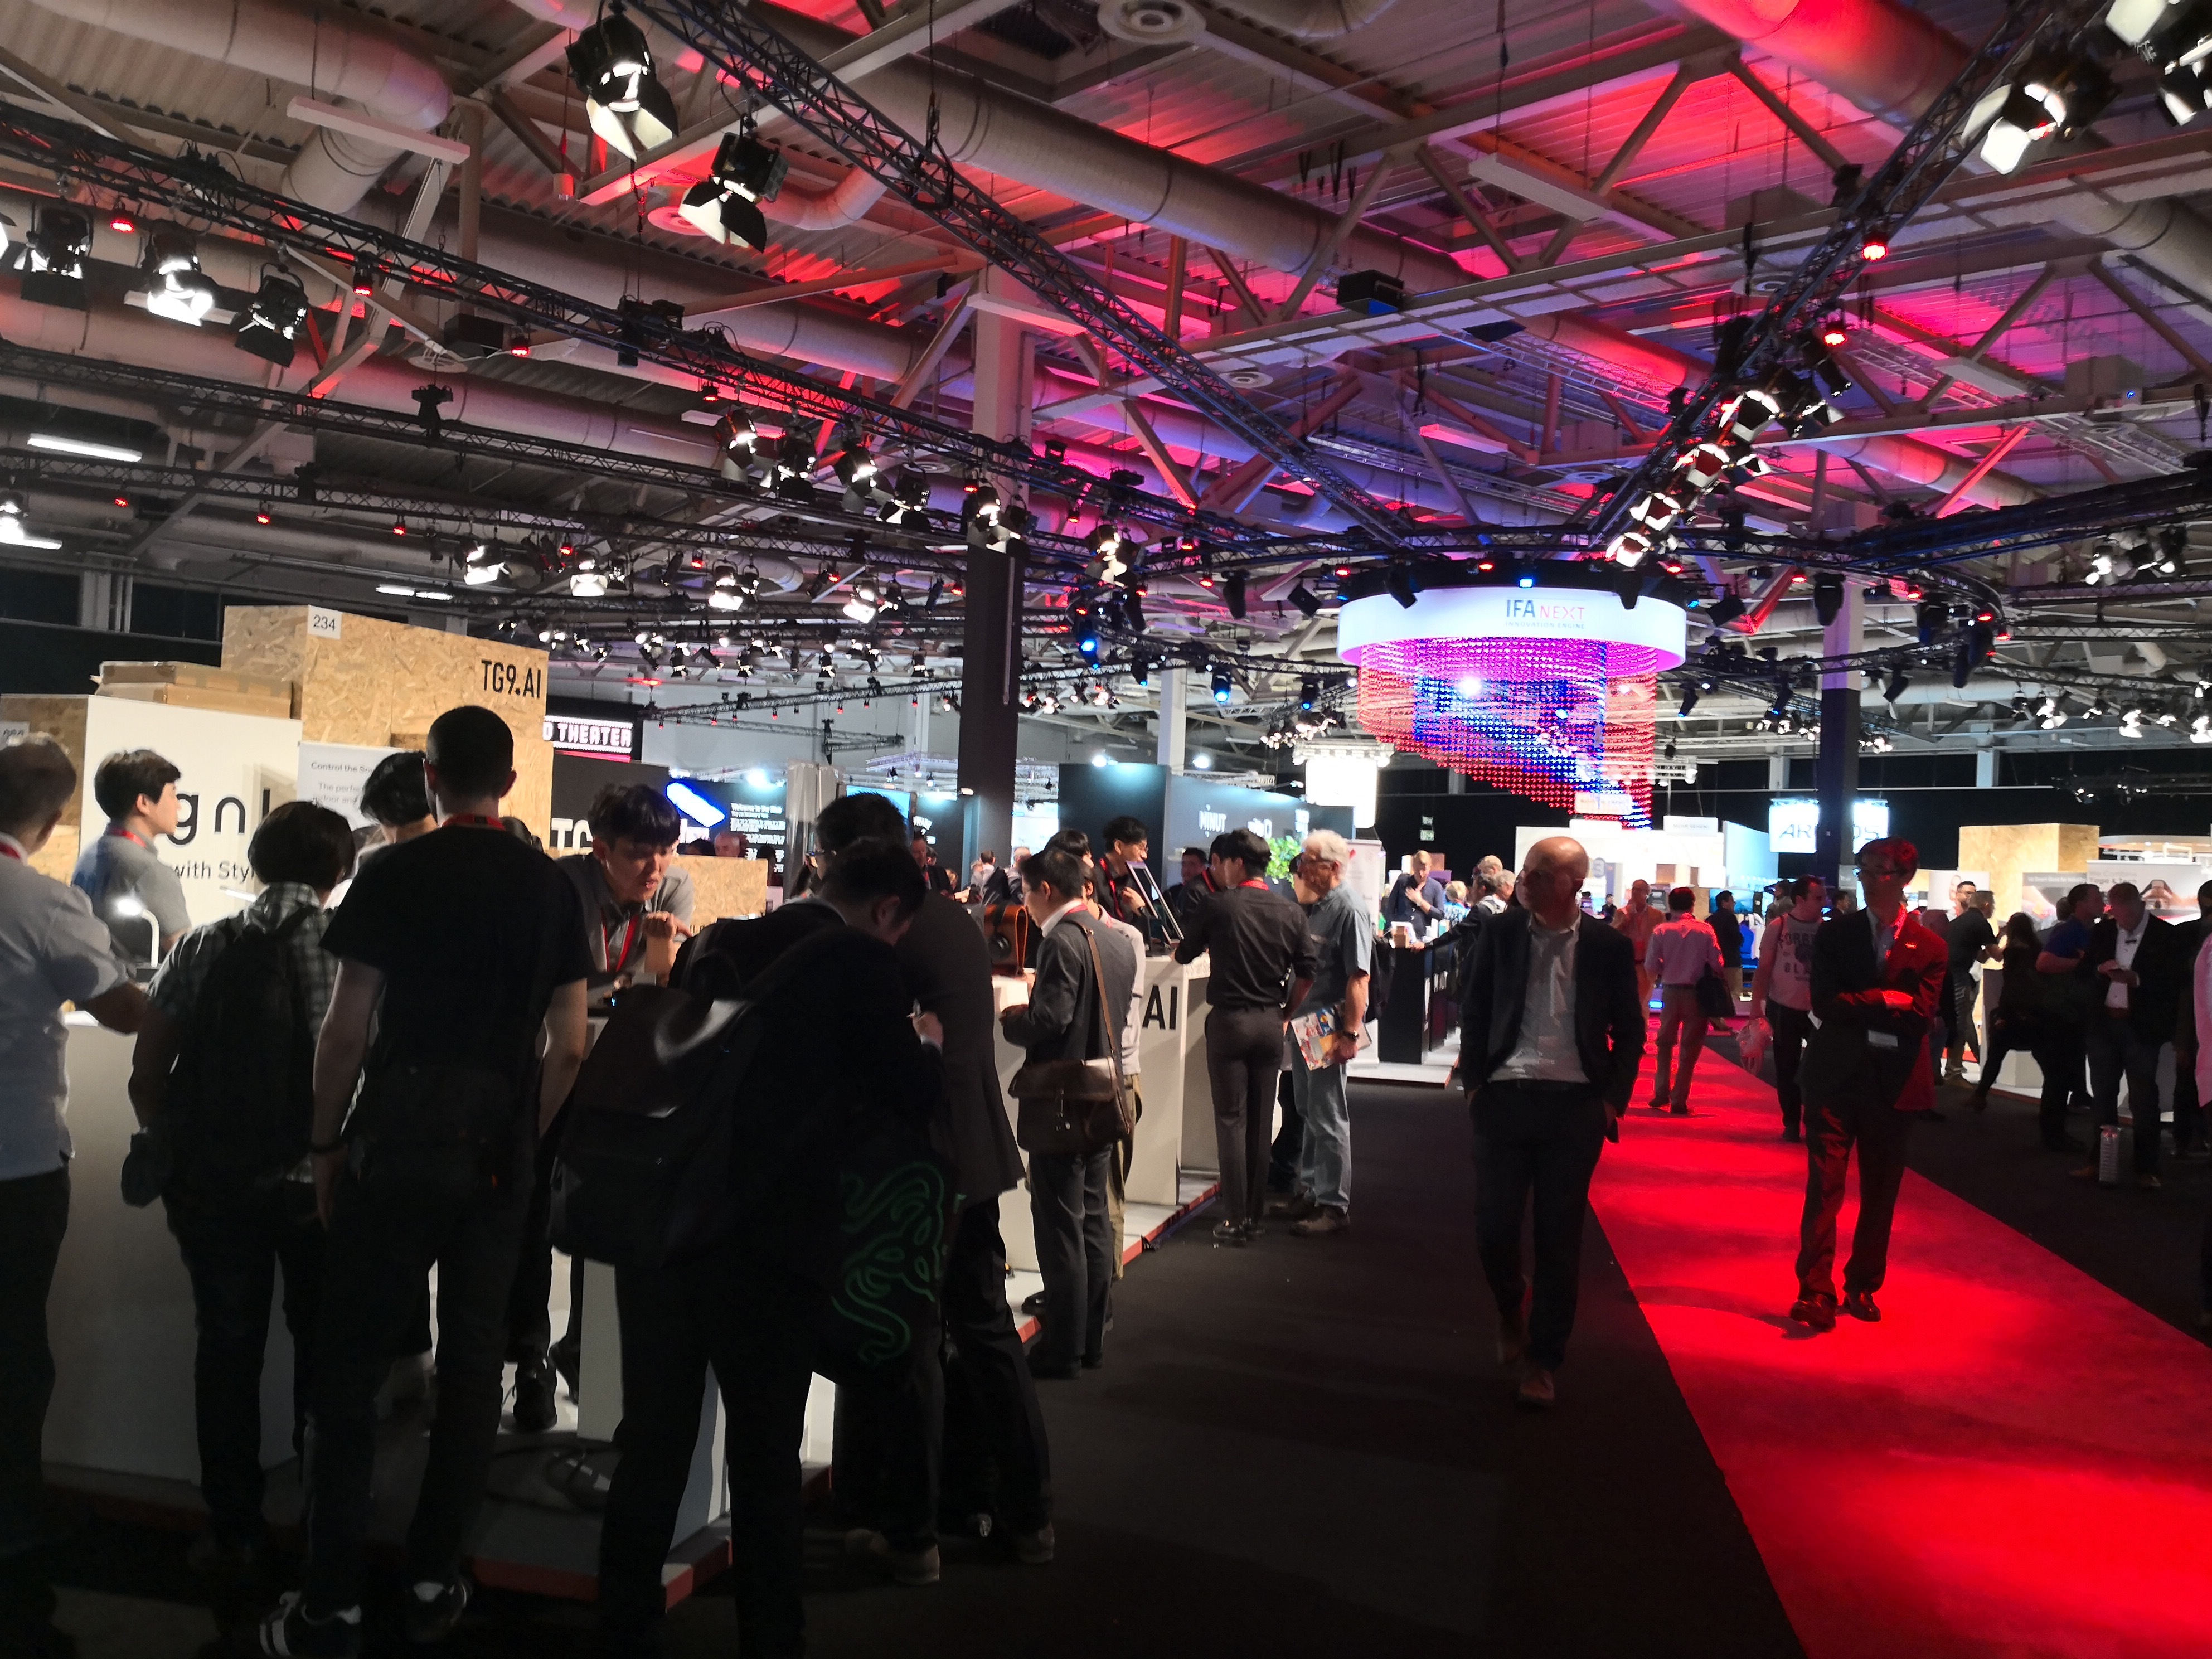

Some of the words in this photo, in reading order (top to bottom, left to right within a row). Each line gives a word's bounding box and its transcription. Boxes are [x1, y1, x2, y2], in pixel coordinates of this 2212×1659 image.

[1507, 600, 1535, 617] IFA
[1540, 605, 1585, 619] NEXT
[313, 614, 336, 632] 234
[481, 659, 541, 699] TG9.AI
[557, 722, 632, 748] THEATER
[311, 761, 342, 772] Control
[345, 765, 357, 773] the
